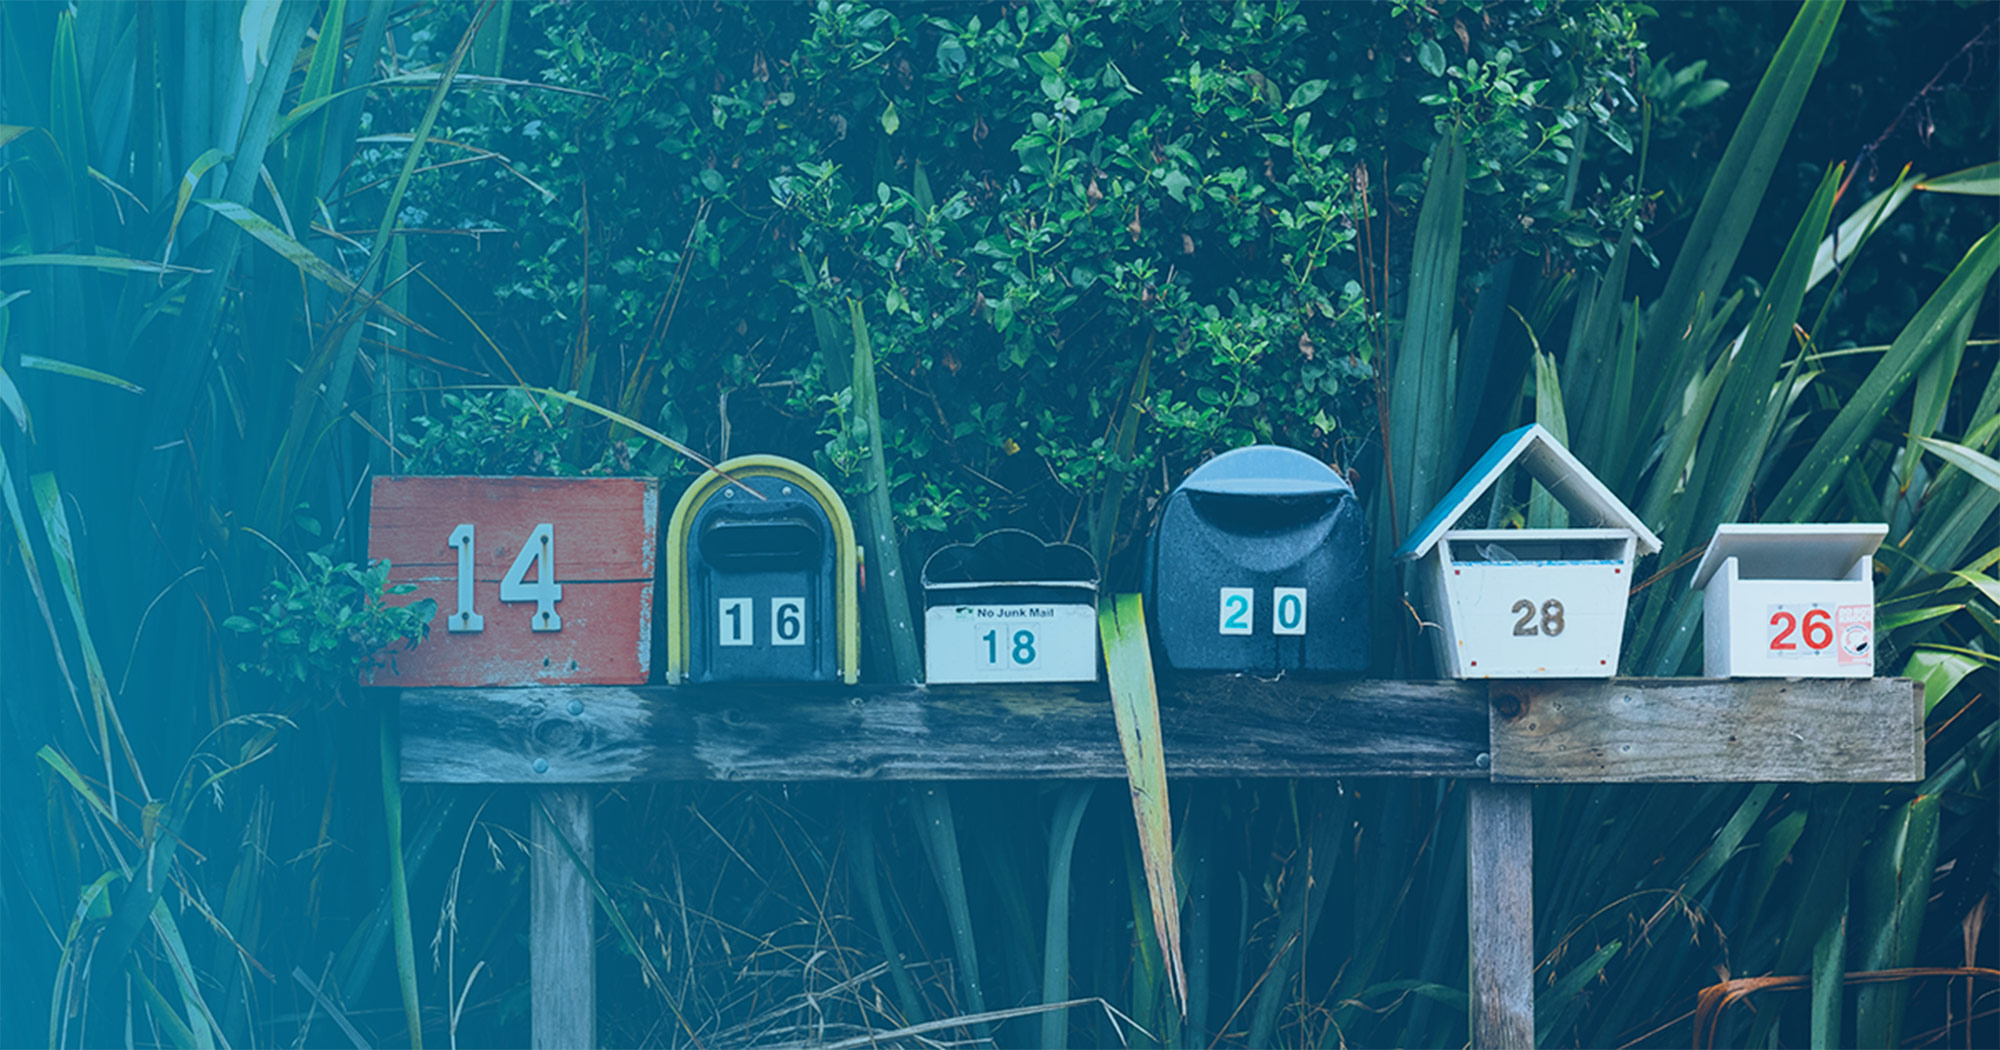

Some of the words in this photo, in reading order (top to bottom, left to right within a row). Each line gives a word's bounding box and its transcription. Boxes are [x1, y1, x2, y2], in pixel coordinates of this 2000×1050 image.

[448, 523, 563, 633] 14
[977, 608, 994, 618] No
[996, 608, 1027, 618] Junk
[1029, 608, 1054, 618] Mail
[1511, 599, 1566, 637] 28
[1769, 608, 1834, 651] 26
[982, 629, 1036, 665] 18
